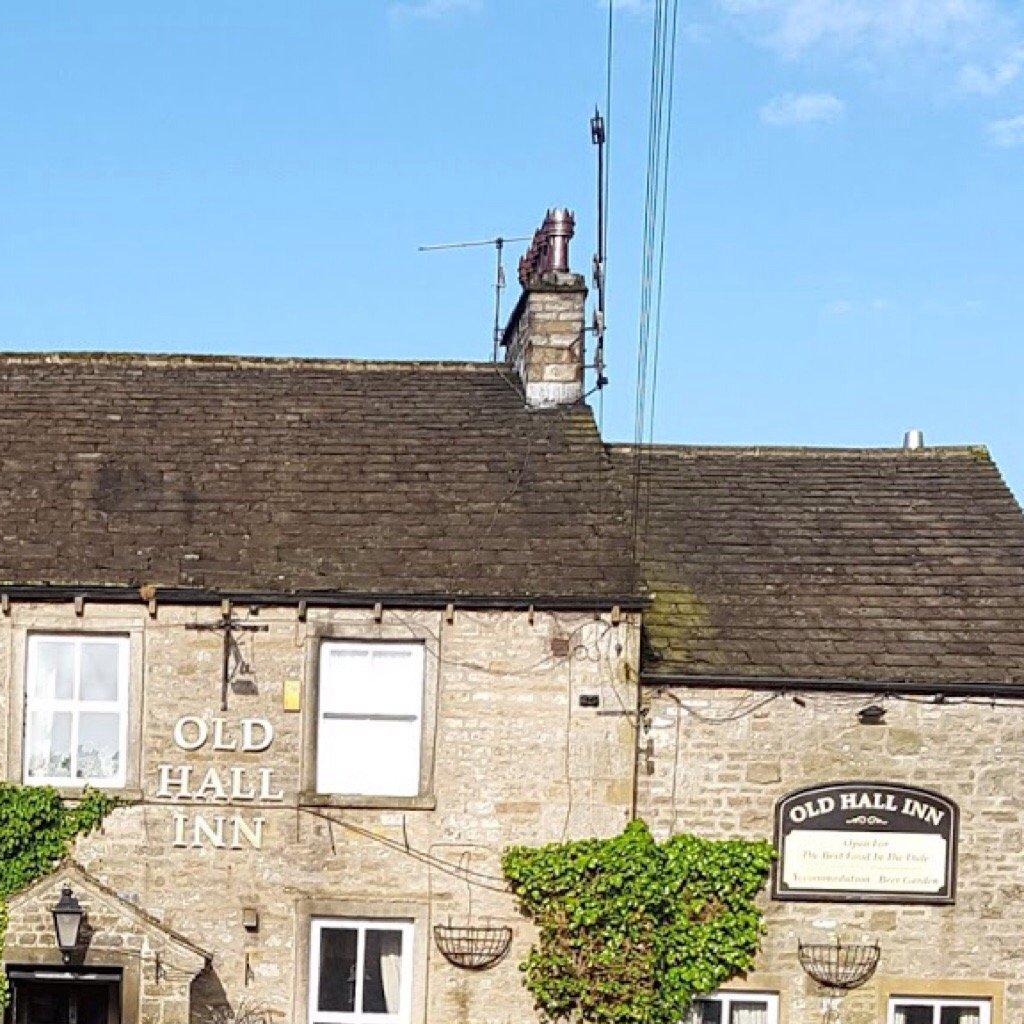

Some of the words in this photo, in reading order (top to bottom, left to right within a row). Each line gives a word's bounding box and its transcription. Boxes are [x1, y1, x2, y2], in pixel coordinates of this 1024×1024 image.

[173, 715, 275, 752] OLD
[156, 763, 284, 802] HALL
[788, 796, 835, 823] OLD
[839, 792, 897, 812] HALL
[901, 797, 945, 826] INN
[172, 811, 266, 850] INN
